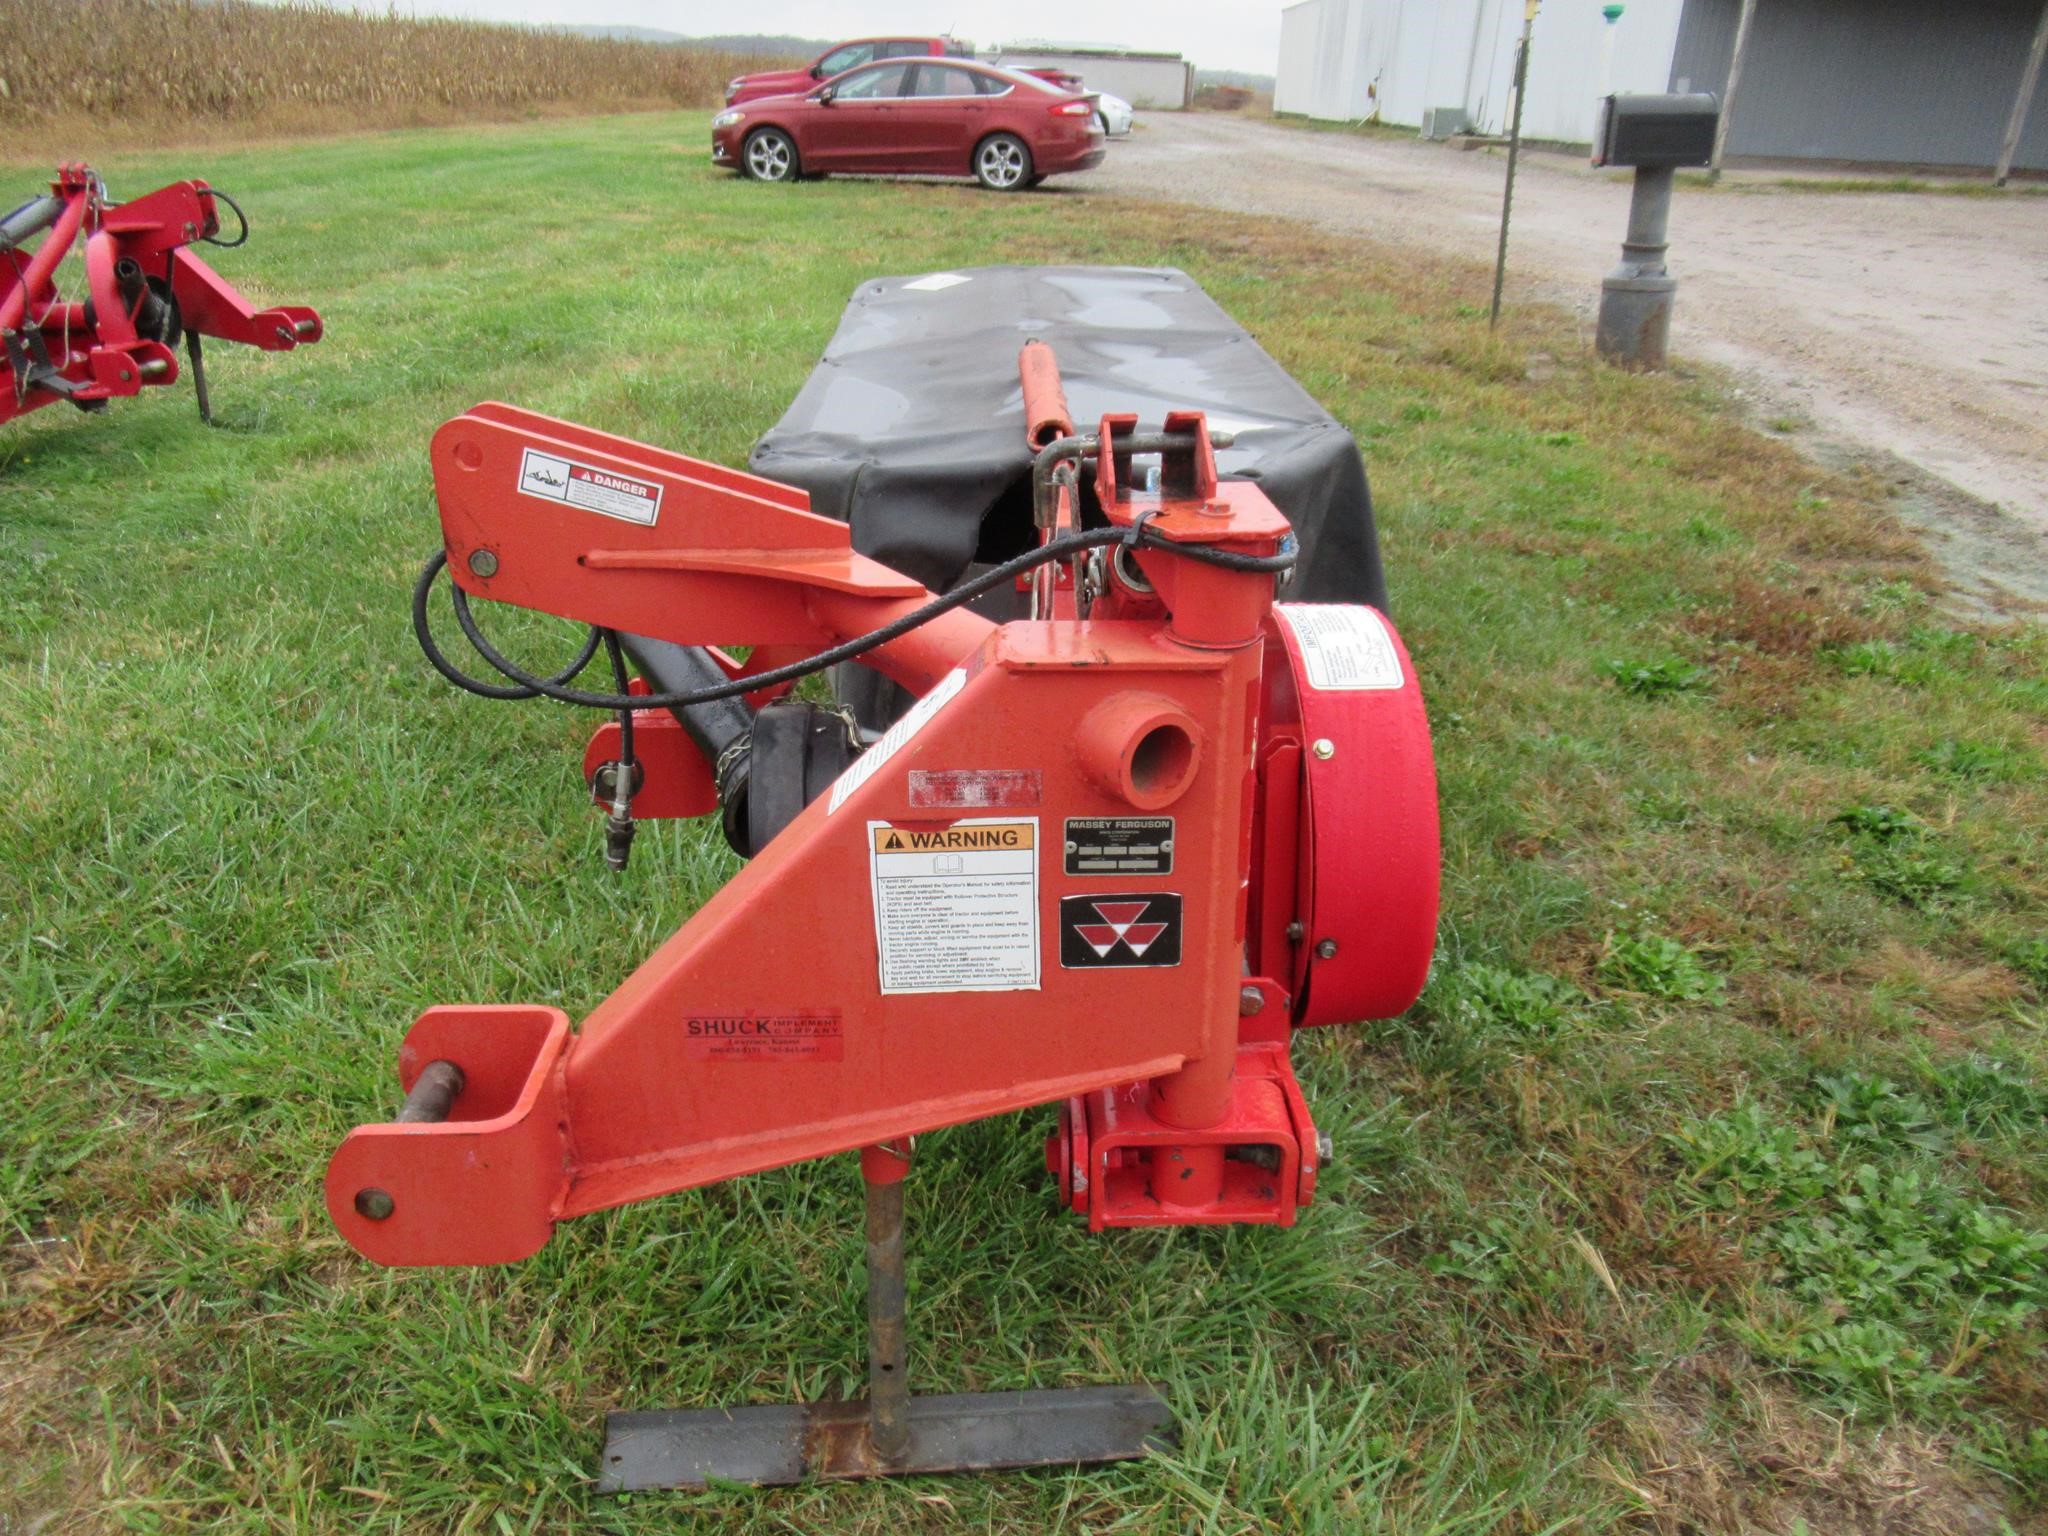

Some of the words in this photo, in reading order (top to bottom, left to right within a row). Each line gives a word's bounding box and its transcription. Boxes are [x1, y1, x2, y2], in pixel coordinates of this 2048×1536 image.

[595, 473, 648, 496] DANGER
[1069, 821, 1111, 829] MASSEY
[1115, 821, 1170, 829] FERGUSON
[910, 830, 1018, 848] WARNING
[687, 1020, 771, 1036] SHUCK
